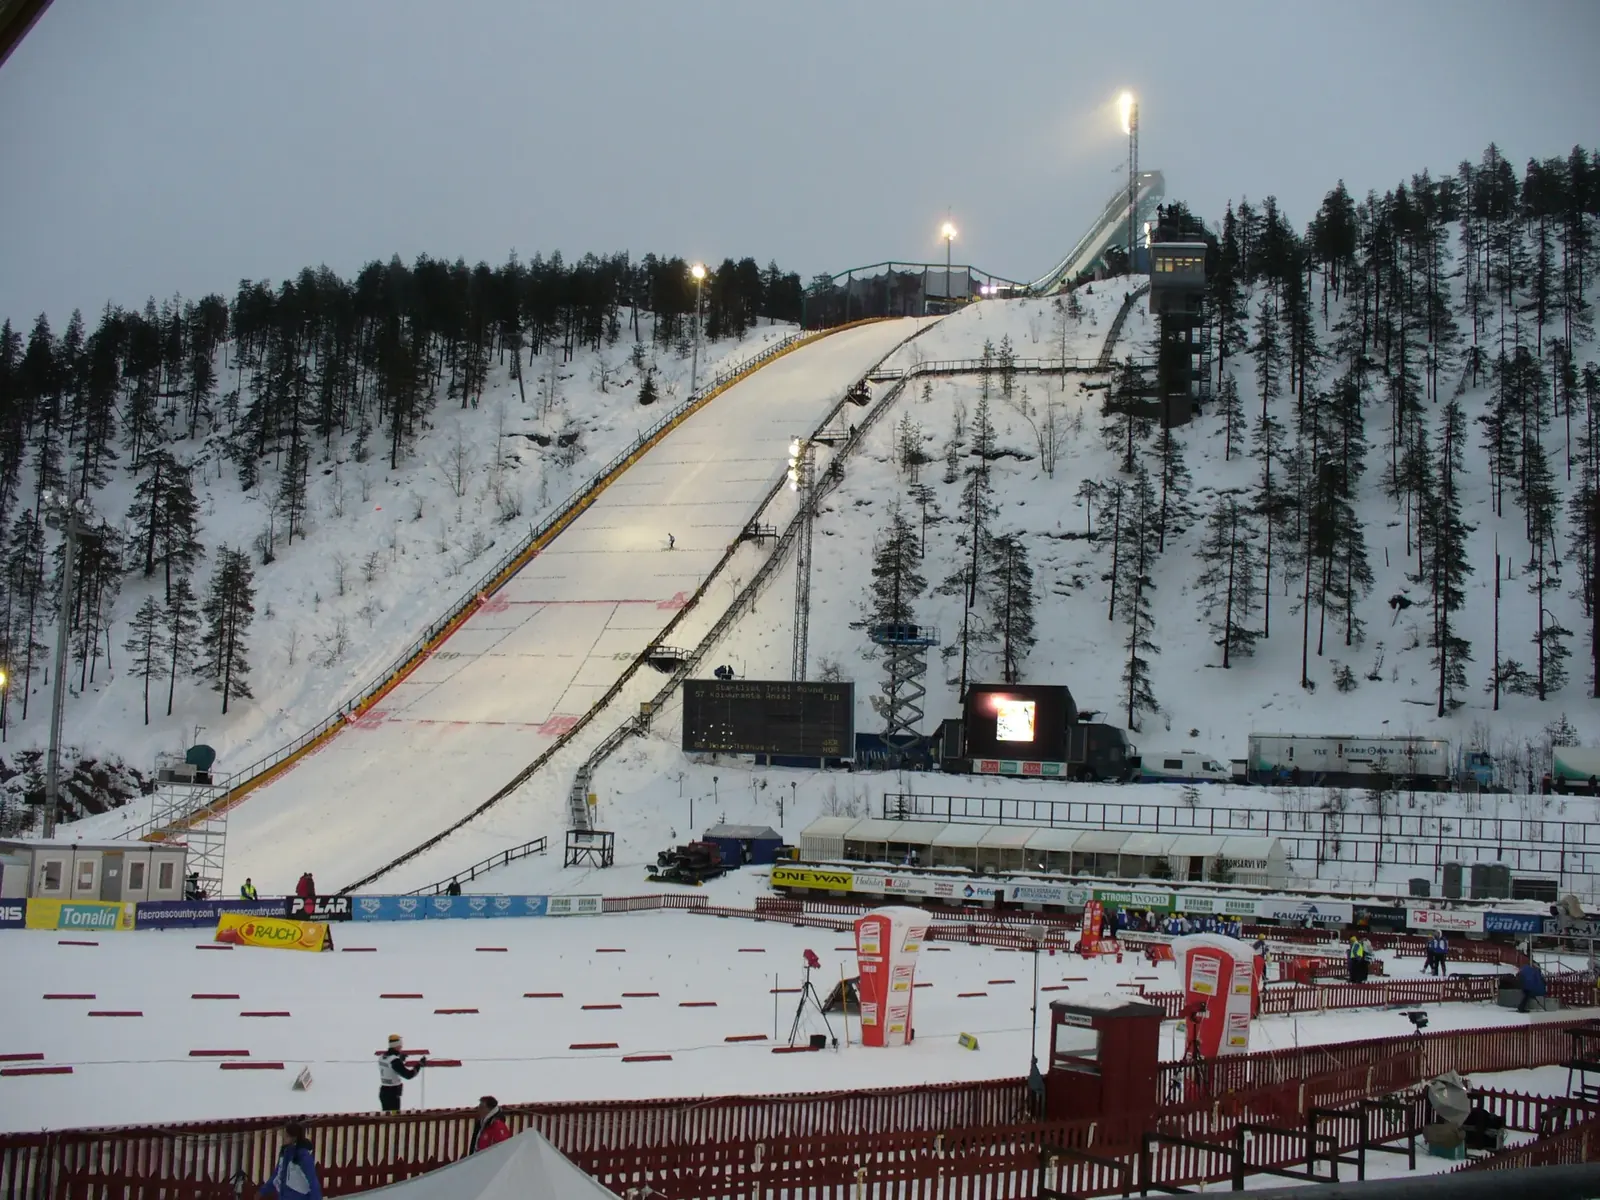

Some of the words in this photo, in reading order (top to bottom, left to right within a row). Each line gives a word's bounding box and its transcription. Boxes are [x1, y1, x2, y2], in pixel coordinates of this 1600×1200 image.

[695, 690, 705, 698] 57
[1256, 860, 1268, 869] VIP
[772, 871, 811, 881] ONE
[813, 874, 852, 884] WAY
[855, 876, 884, 887] Holiday
[893, 878, 912, 888] Club
[1101, 892, 1131, 902] STRONG
[1134, 895, 1167, 904] WOOD
[291, 898, 348, 915] POLAR
[137, 908, 214, 920] fiscrosscountry.com
[1486, 920, 1535, 931] vauhti
[254, 925, 297, 941] RAUCH
